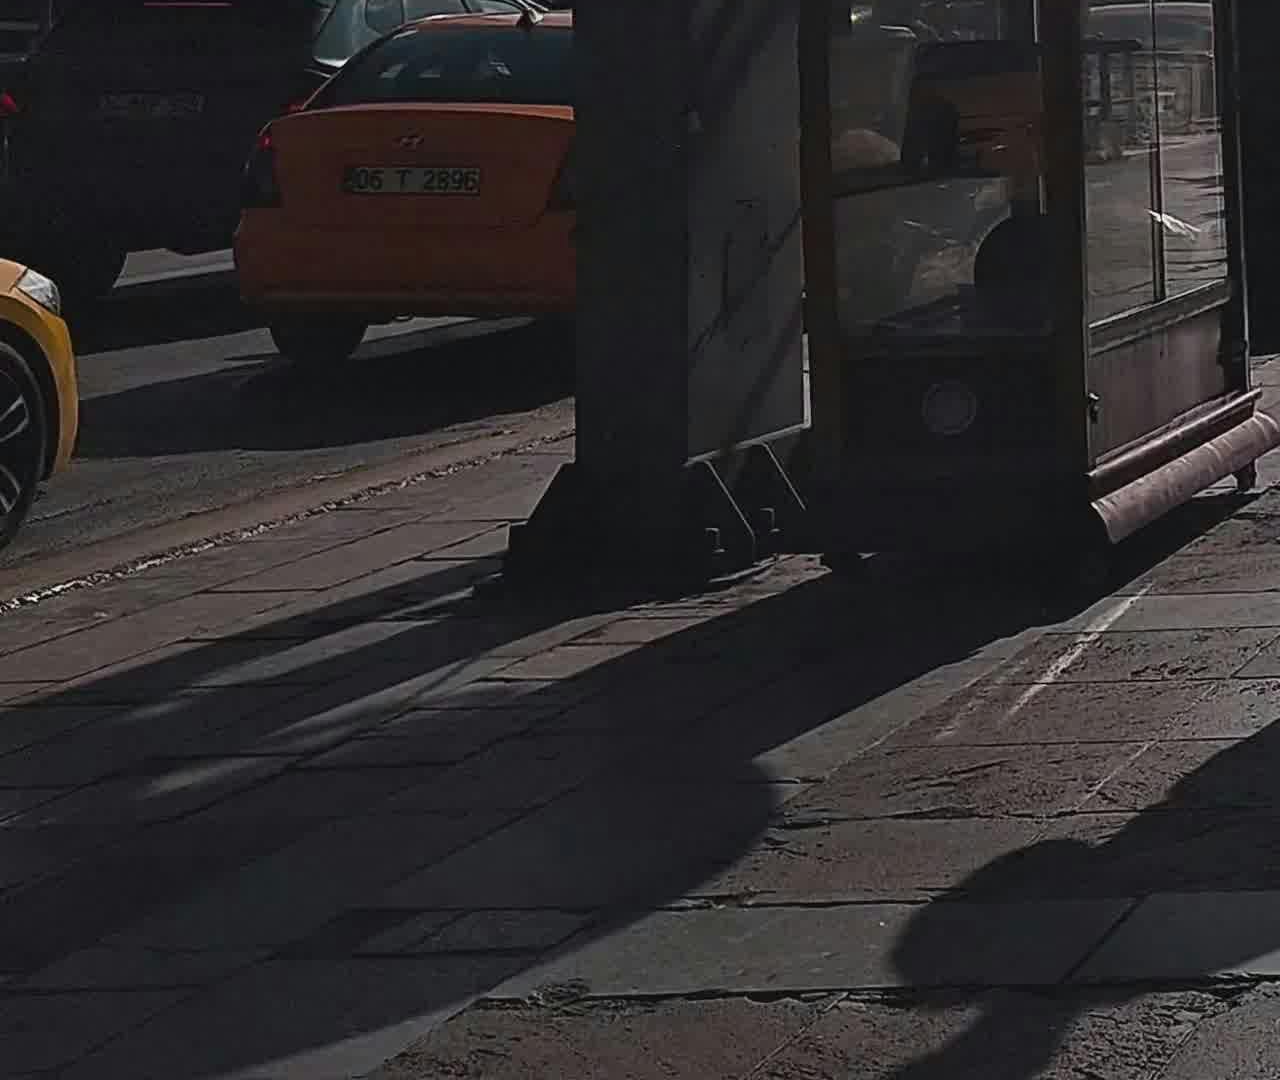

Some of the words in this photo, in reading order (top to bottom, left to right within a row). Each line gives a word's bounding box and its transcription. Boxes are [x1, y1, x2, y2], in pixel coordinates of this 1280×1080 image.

[353, 168, 384, 191] 06
[394, 168, 413, 189] T
[423, 168, 479, 191] 2896
